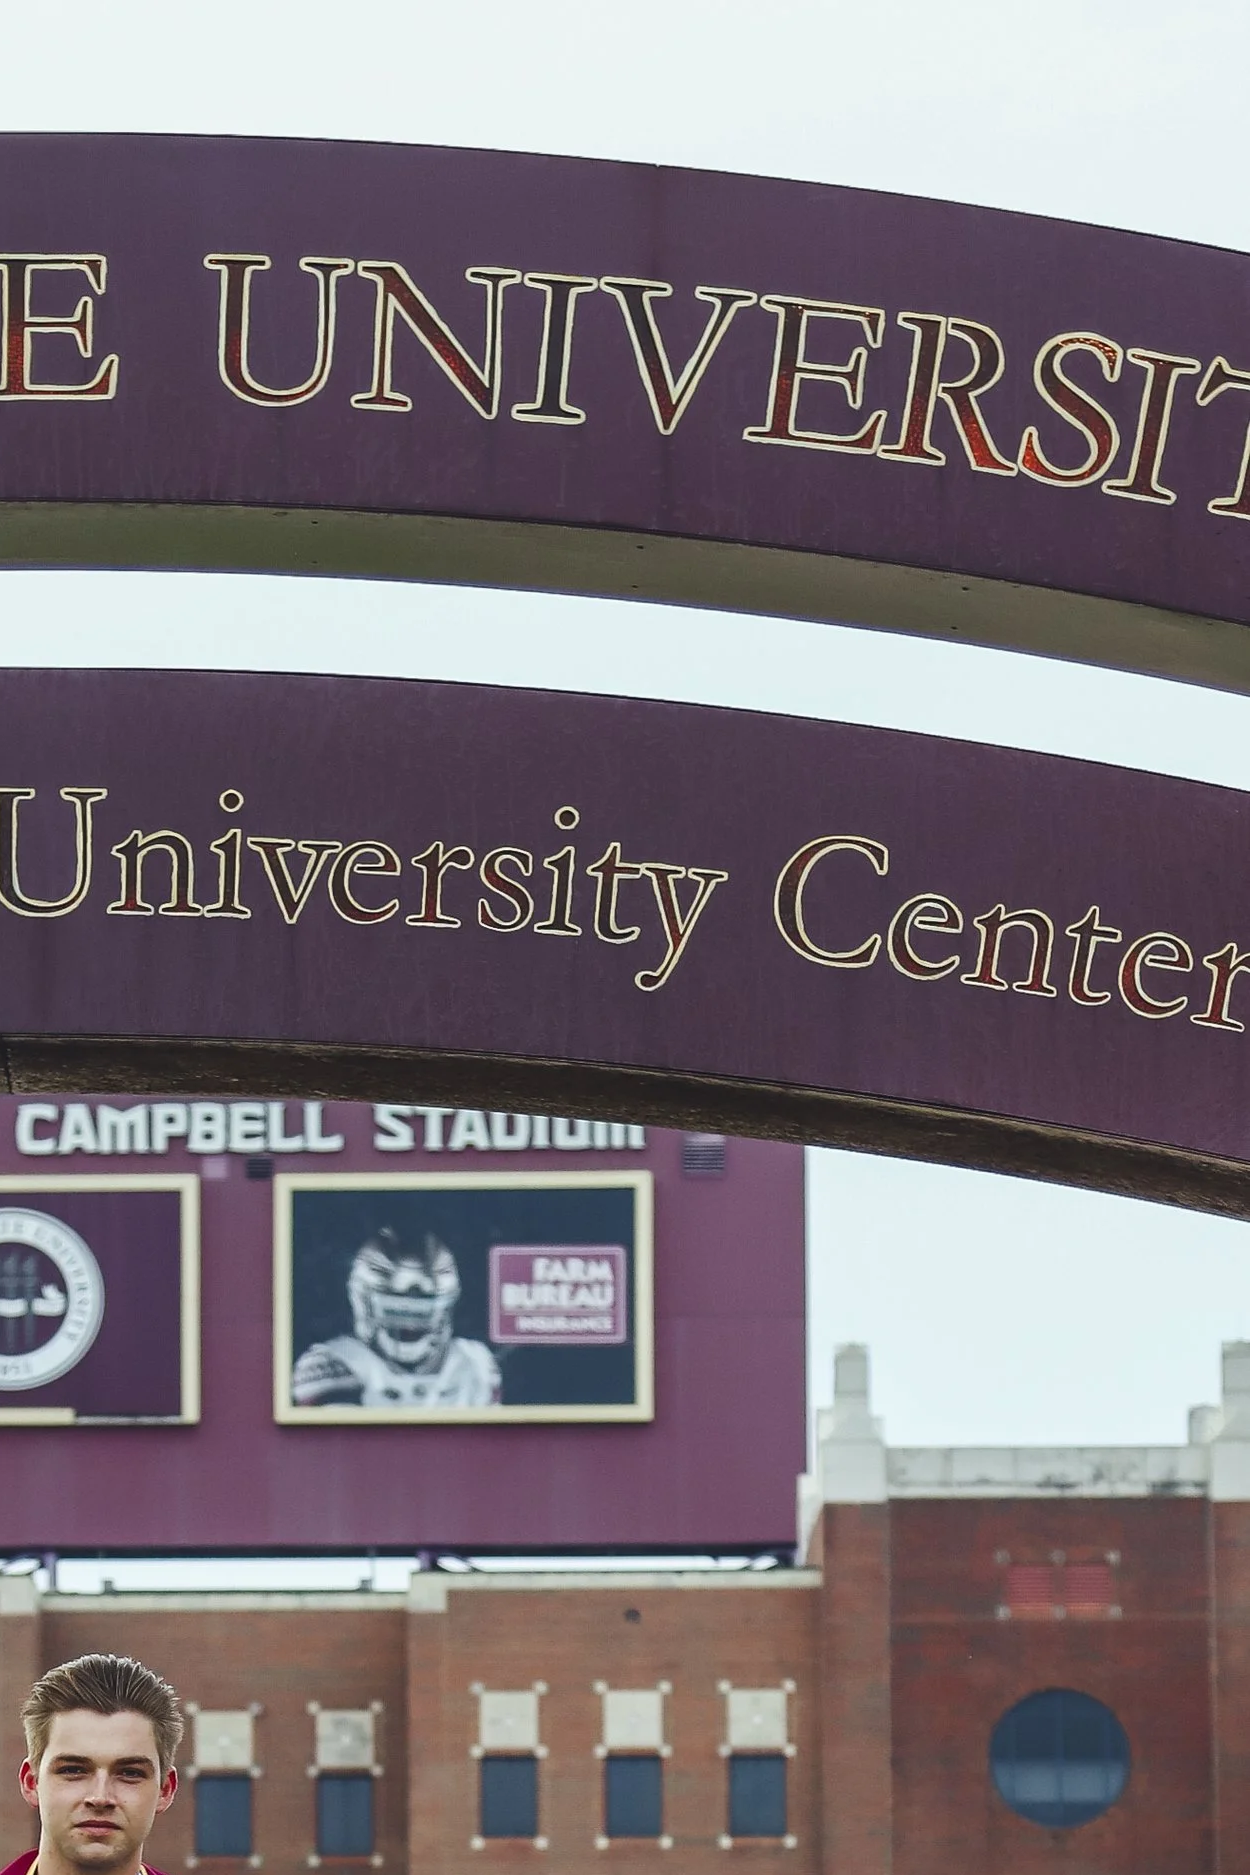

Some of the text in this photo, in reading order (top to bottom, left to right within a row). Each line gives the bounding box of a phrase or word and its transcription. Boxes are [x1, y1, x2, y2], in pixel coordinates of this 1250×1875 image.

[774, 836, 1250, 1033] Center
[16, 1101, 344, 1154] CAMPBELL
[533, 1257, 613, 1281] FARM
[501, 1282, 614, 1310] BUREAU
